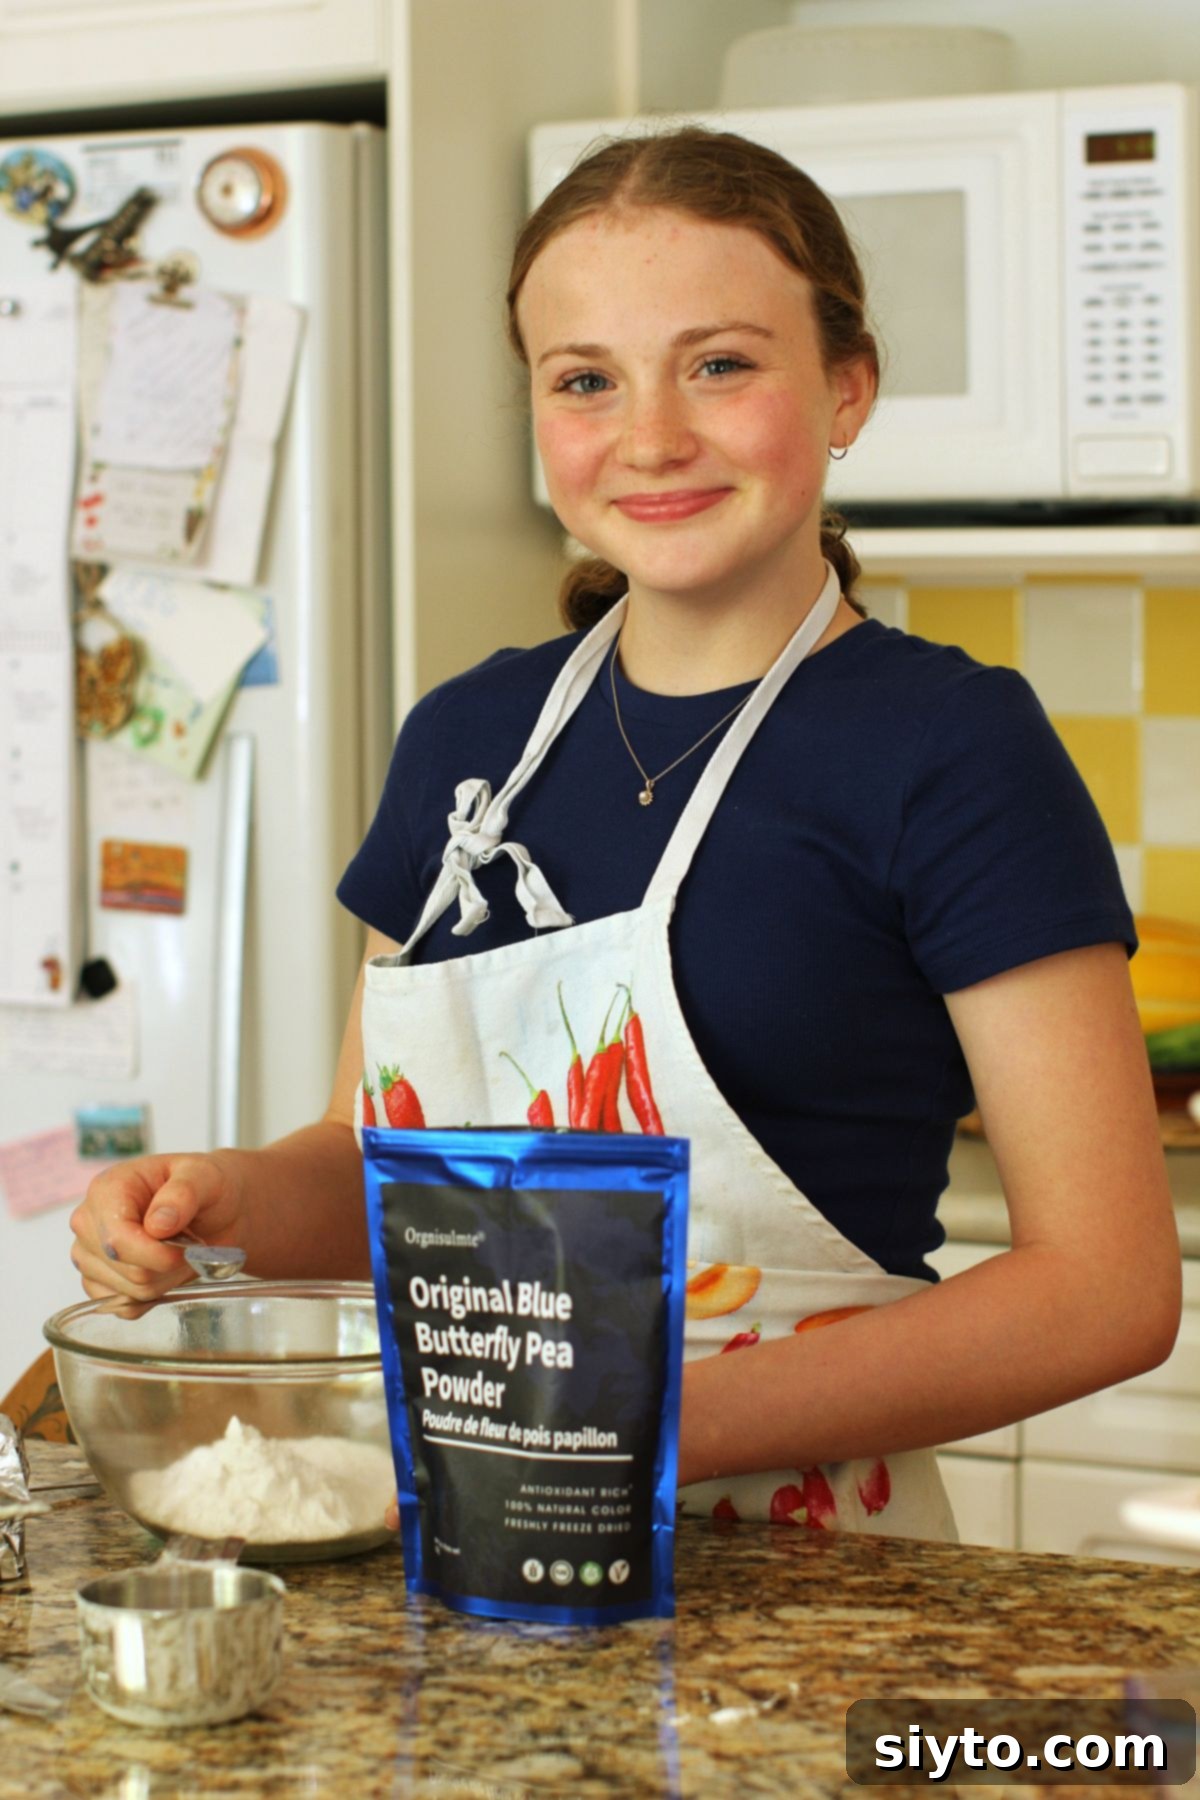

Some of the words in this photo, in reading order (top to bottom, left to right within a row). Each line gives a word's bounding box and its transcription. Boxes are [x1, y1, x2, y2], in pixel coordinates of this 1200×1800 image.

[409, 1275, 514, 1320] Original
[517, 1280, 573, 1321] Blue
[414, 1322, 522, 1371] Butterfly
[525, 1331, 574, 1369] Pea
[420, 1367, 506, 1408] Powder
[422, 1409, 462, 1433] Poudre
[463, 1415, 479, 1435] de
[480, 1416, 507, 1441] fleur
[508, 1421, 522, 1442] de
[522, 1425, 551, 1448] pois
[553, 1426, 618, 1452] papillon
[504, 1499, 533, 1513] 100%
[537, 1503, 586, 1516] NATURAL
[520, 1484, 595, 1498] ANTIOXIDANT
[504, 1517, 548, 1532] FRESHLY
[552, 1521, 592, 1533] FREEZE
[598, 1521, 631, 1534] DRIED
